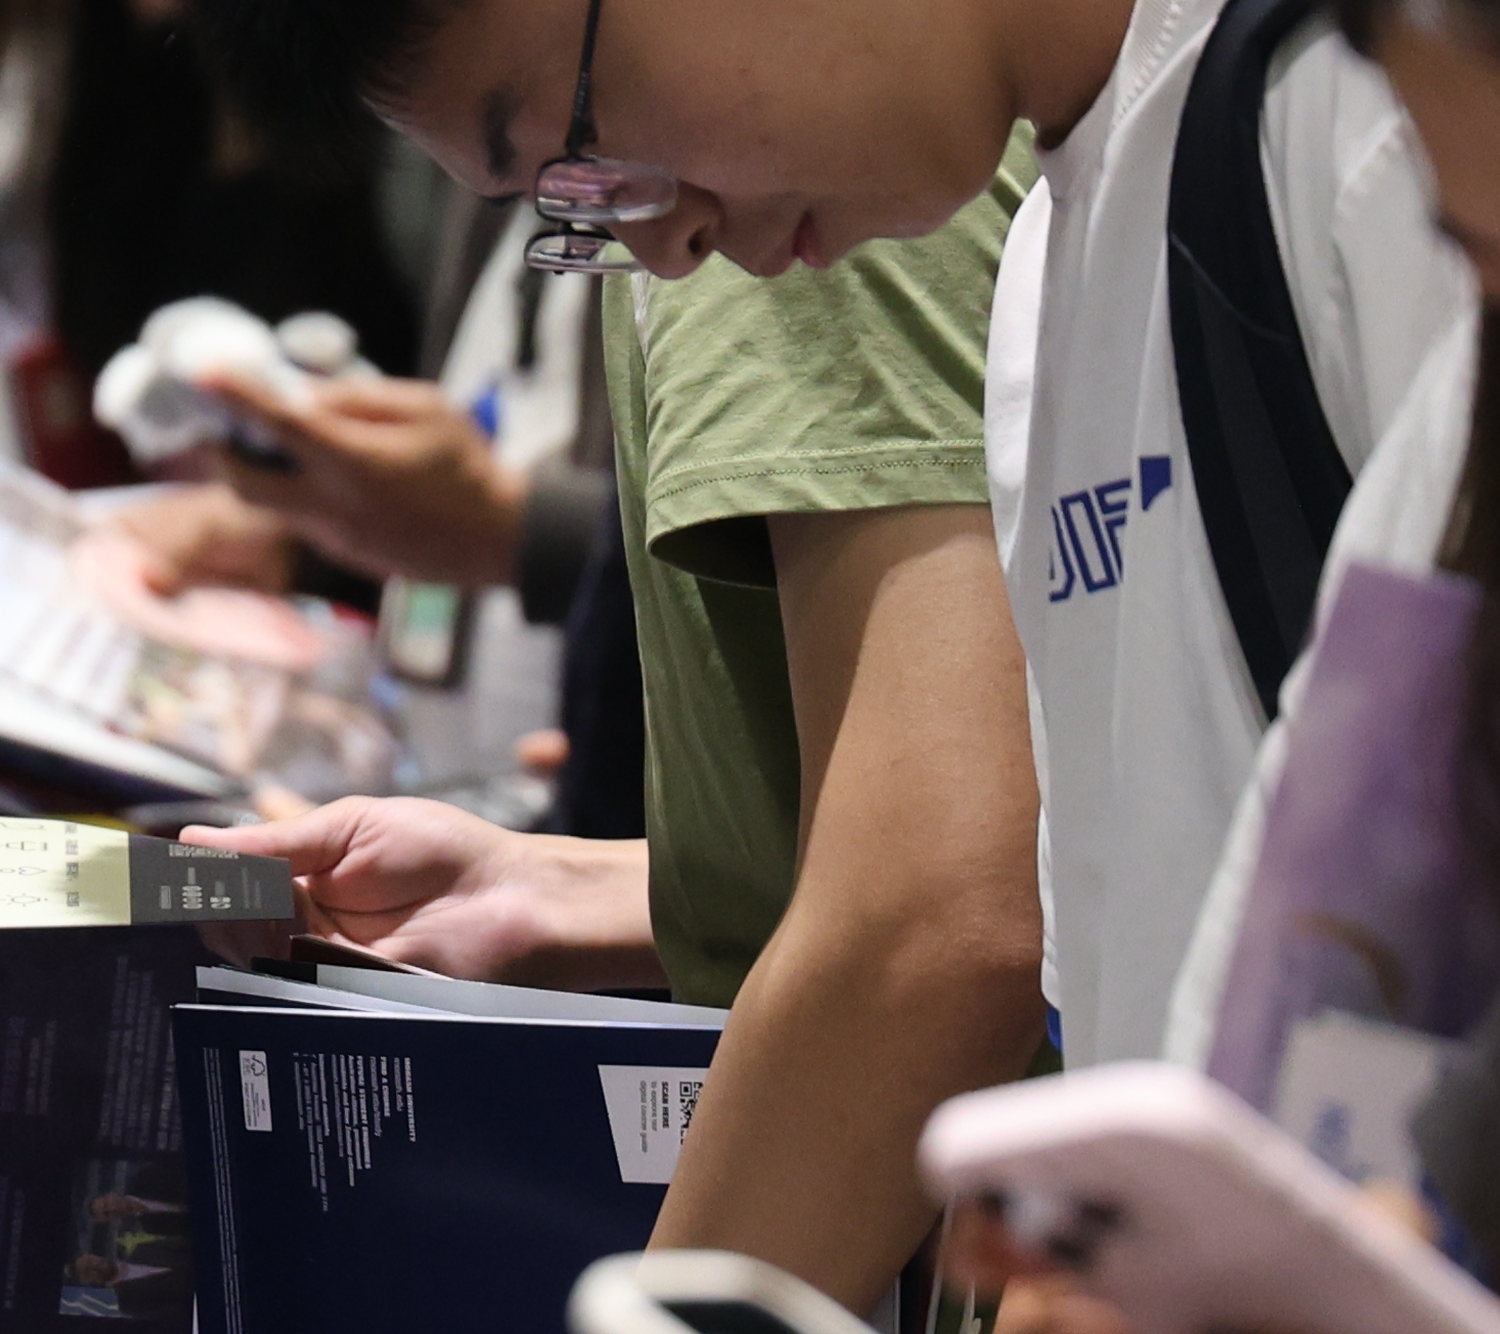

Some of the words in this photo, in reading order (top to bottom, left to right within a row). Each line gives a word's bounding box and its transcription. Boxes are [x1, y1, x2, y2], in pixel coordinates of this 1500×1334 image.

[404, 1057, 412, 1093] MONASH
[406, 1094, 416, 1142] UNIVERSITY
[662, 1106, 670, 1128] HERE
